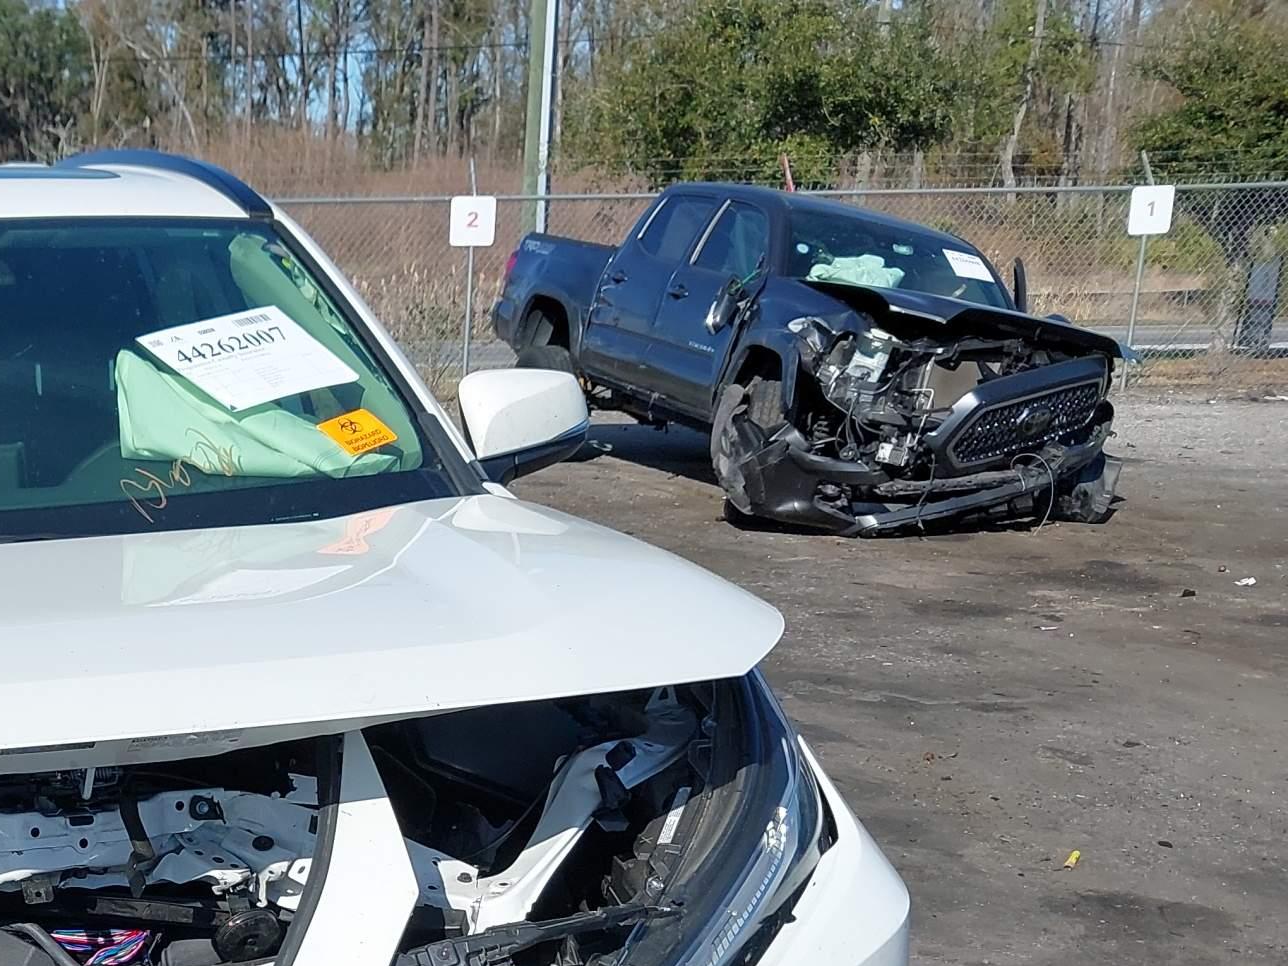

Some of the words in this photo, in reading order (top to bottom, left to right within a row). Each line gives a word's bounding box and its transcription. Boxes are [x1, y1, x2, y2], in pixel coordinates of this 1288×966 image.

[1147, 200, 1155, 217] 1
[466, 211, 479, 228] 2
[177, 326, 287, 363] 44262007
